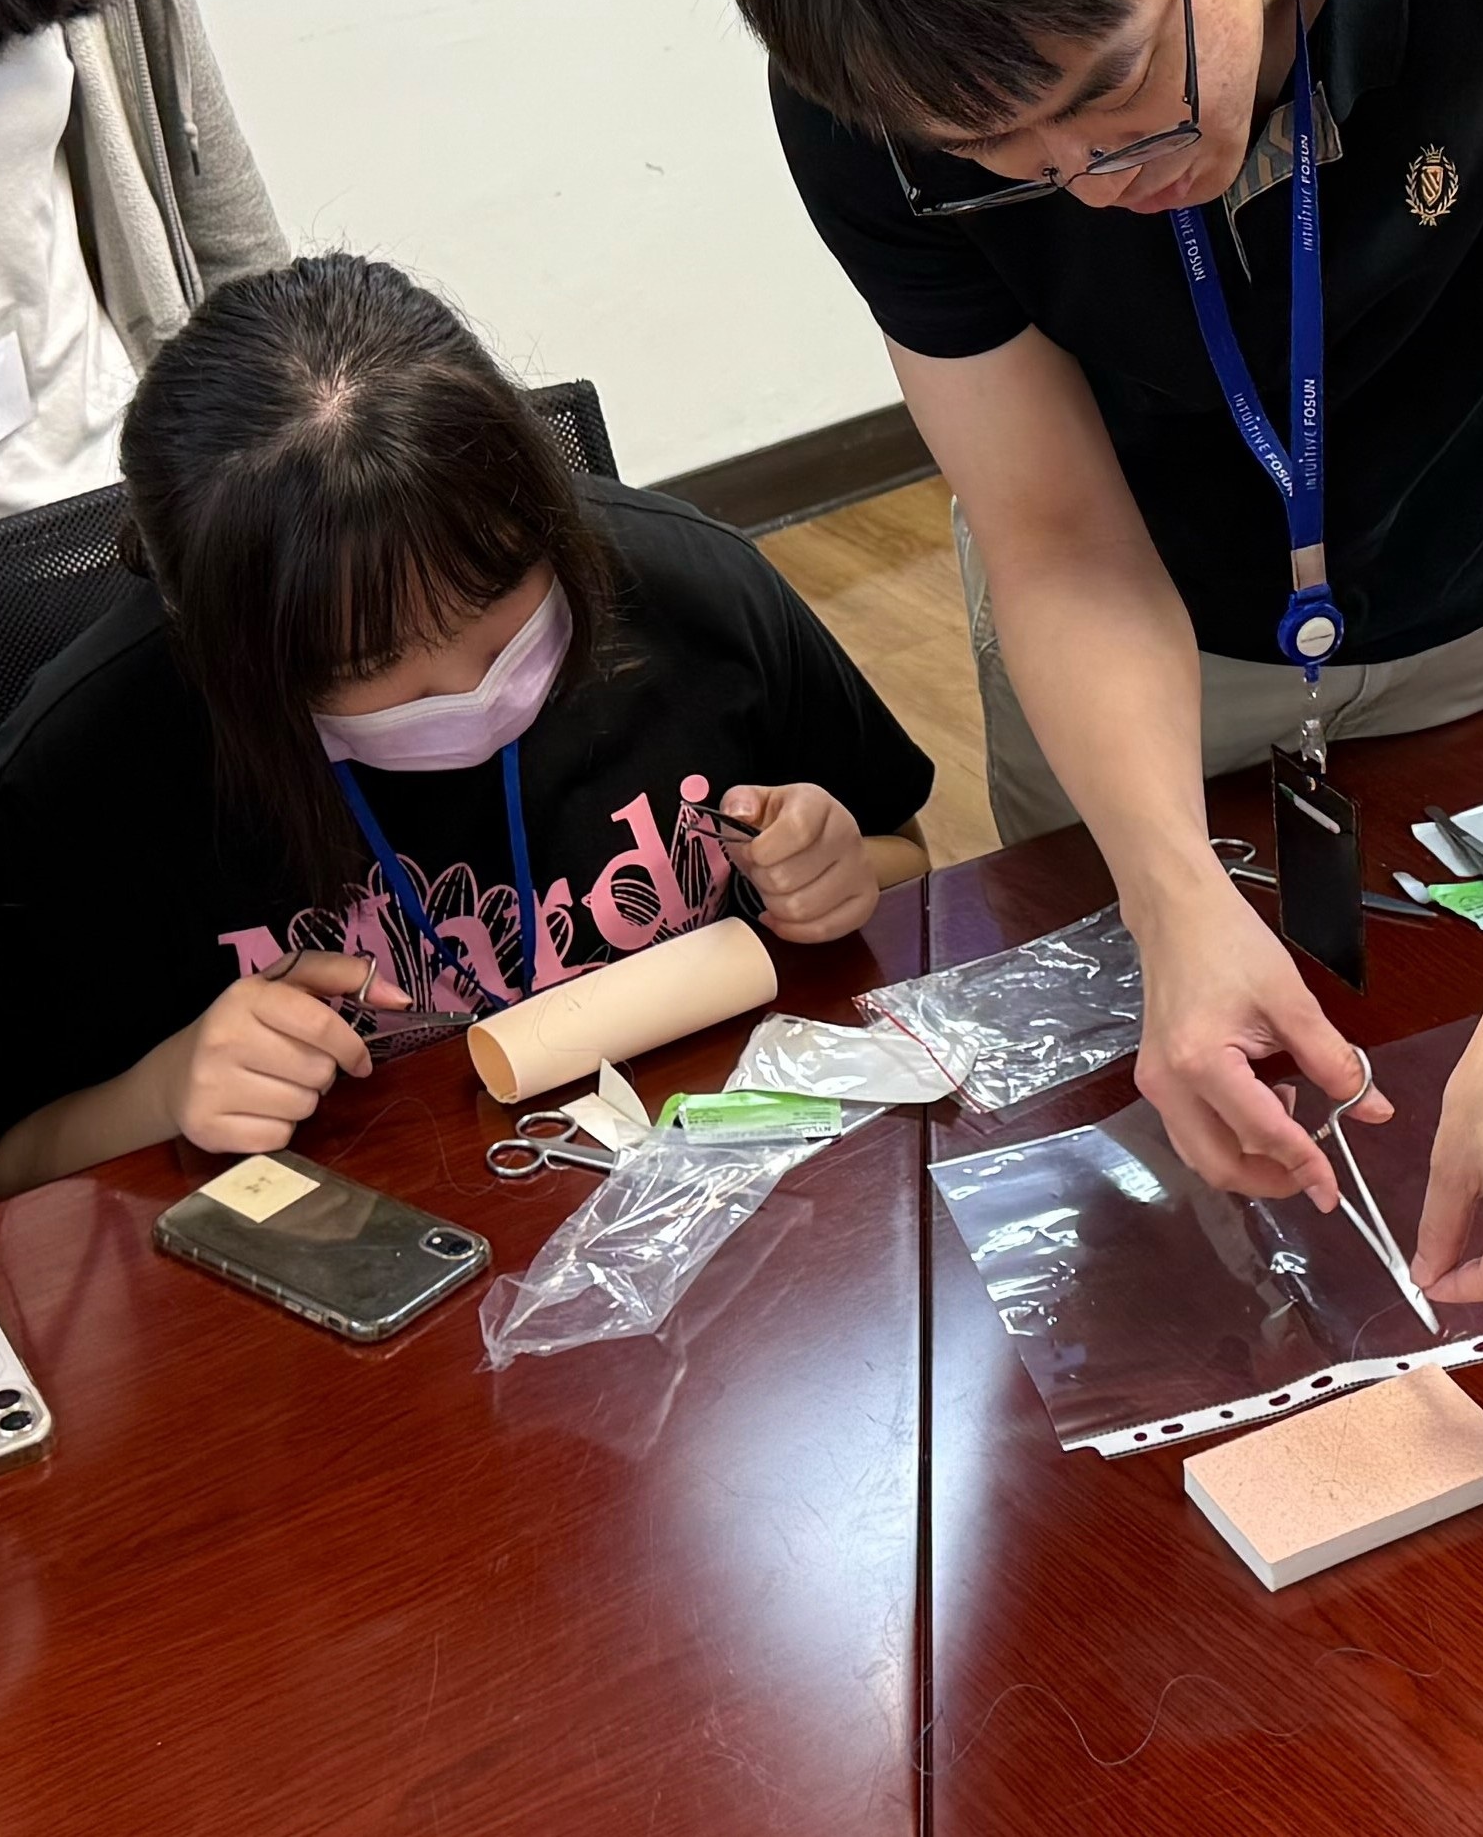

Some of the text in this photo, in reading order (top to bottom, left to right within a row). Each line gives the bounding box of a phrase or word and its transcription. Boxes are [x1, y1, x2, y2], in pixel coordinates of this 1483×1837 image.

[1300, 134, 1311, 184] FOSUN
[1184, 238, 1206, 281] FOSUN
[1303, 378, 1317, 426] FOSUN
